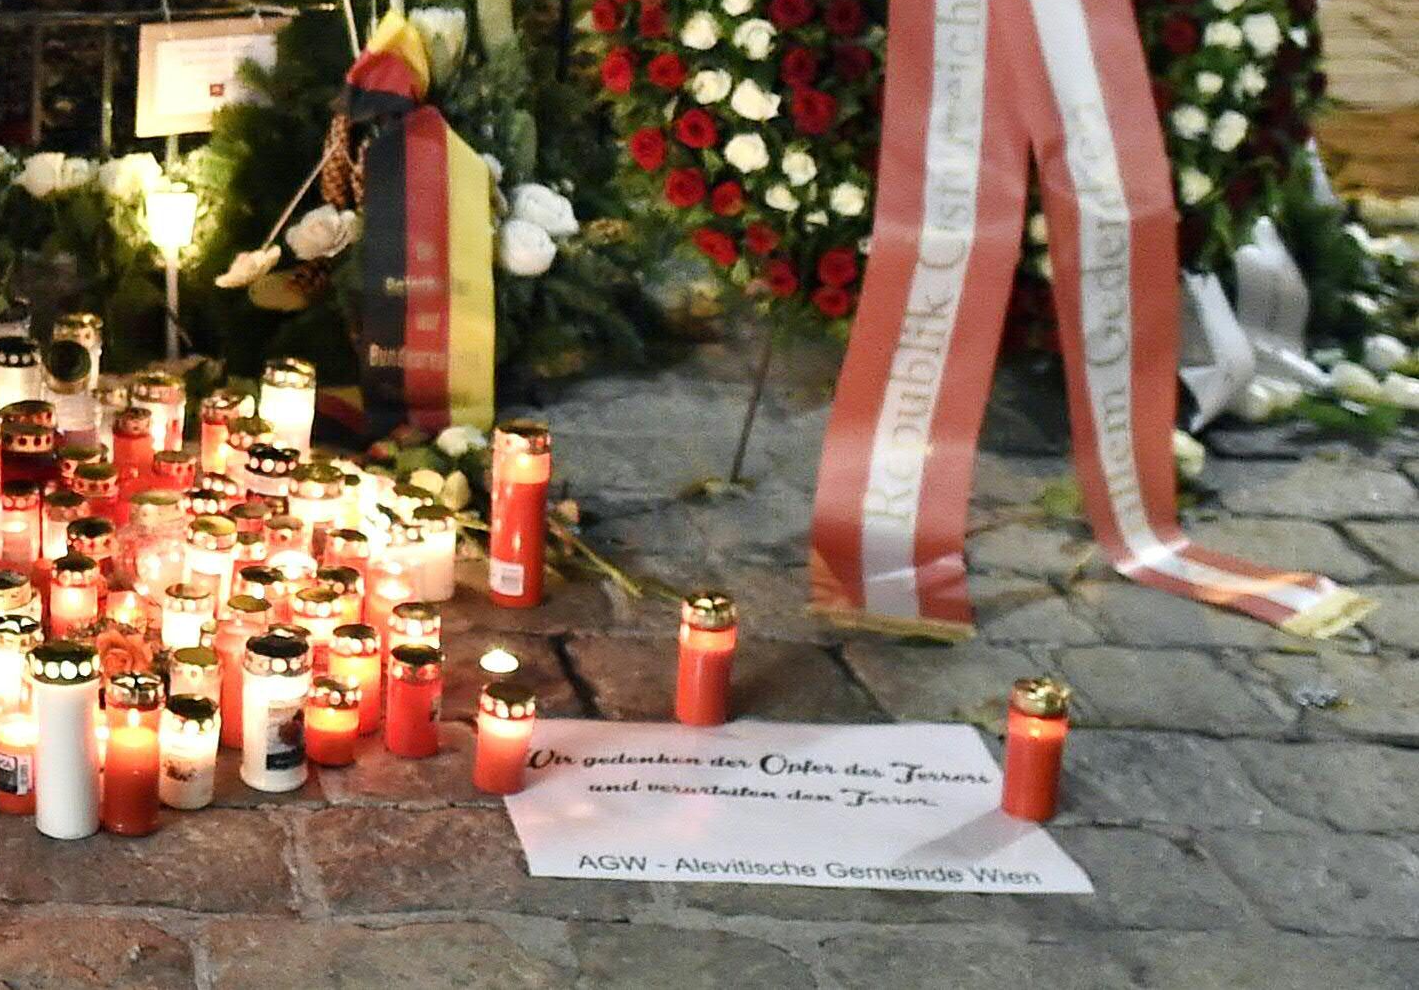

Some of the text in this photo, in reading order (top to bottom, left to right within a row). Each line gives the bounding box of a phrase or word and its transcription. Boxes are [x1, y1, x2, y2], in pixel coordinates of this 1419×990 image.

[710, 759, 752, 769] der
[759, 754, 836, 776] Opfer
[588, 780, 641, 794] und
[579, 855, 647, 872] AGW
[675, 857, 817, 877] Alevitische
[825, 861, 964, 884] Gemeinde
[968, 865, 1043, 886] Wien
